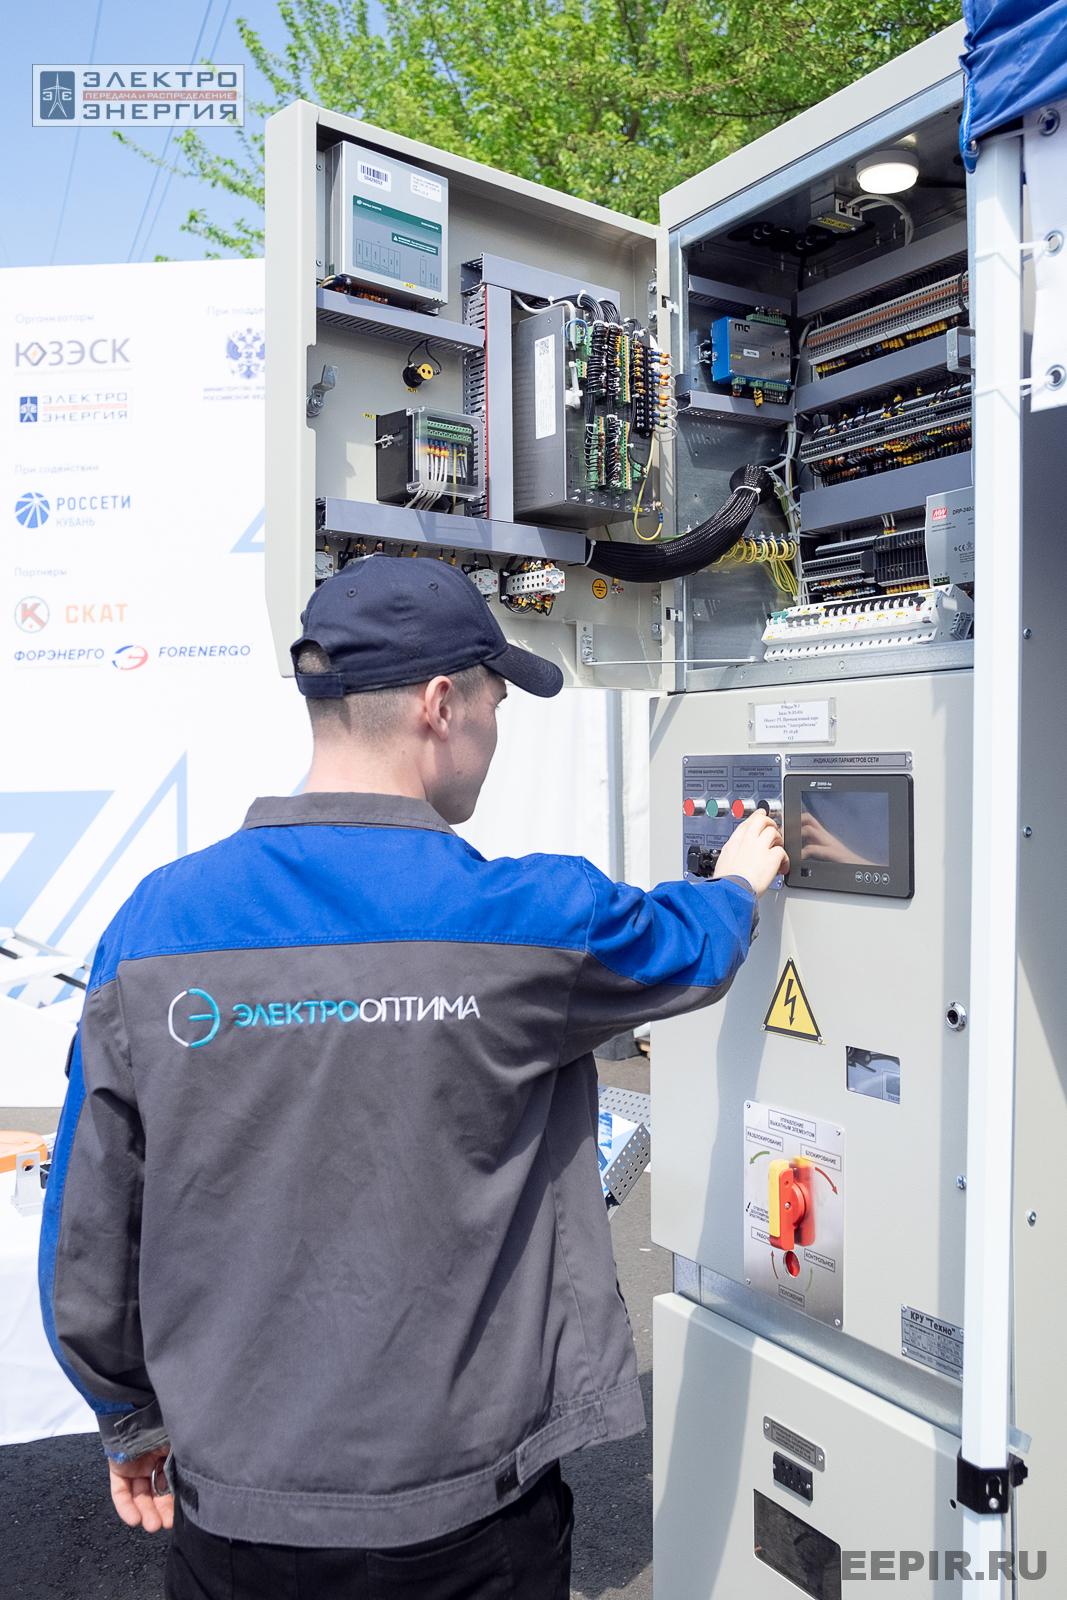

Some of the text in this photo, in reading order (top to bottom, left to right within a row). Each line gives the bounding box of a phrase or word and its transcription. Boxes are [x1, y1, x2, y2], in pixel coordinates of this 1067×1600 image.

[15, 338, 130, 367] ЮЗЭСК
[43, 392, 128, 404] ЭЛЕКТРО
[43, 410, 128, 422] ЭНЕРГИЯ
[56, 495, 131, 510] РОССЕТИ
[56, 517, 95, 528] КУБАНЬ
[66, 603, 128, 624] СКАТ
[14, 648, 104, 661] ФОРЭНЕРГО
[158, 645, 251, 658] FORENERGO
[232, 995, 480, 1027] ЭЛЕКТРООПТИМА
[910, 1310, 956, 1336] КРУ "Техно"
